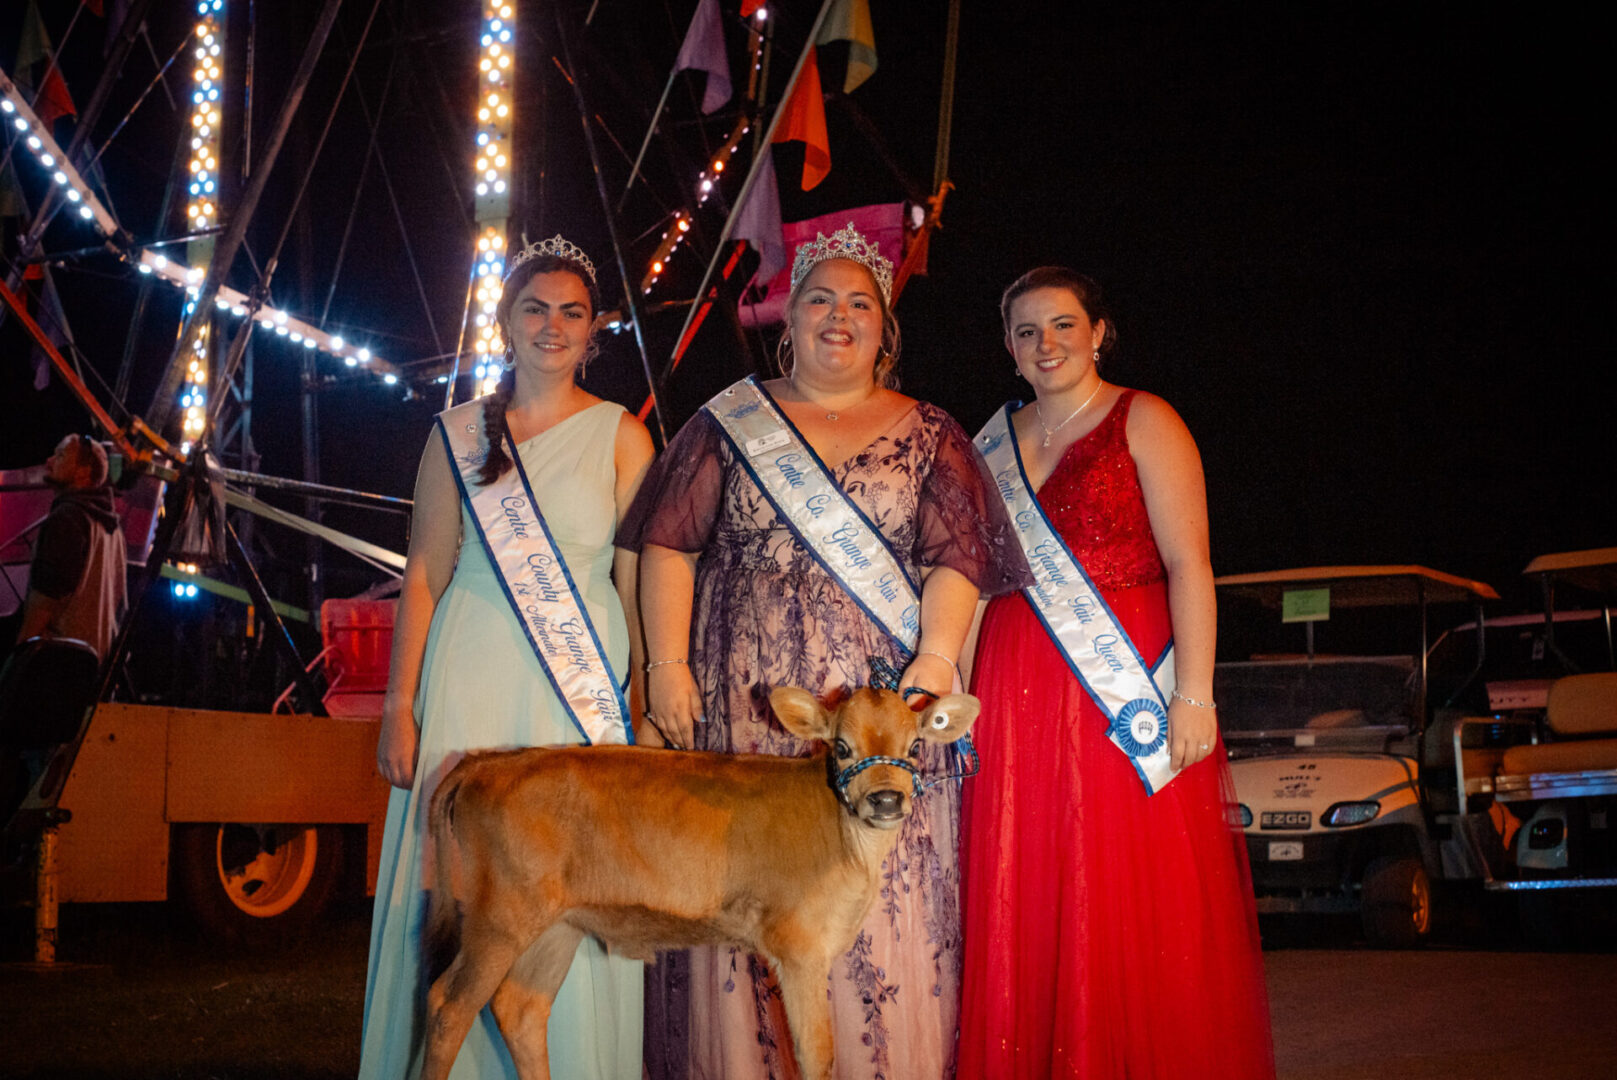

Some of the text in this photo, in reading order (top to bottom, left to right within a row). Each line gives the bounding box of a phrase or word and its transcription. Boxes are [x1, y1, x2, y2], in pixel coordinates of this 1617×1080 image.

[501, 496, 615, 720] Centre County Grange Fair
[514, 582, 559, 657] 1st Alternate
[775, 453, 919, 634] Centre Co. Grange Fair Que
[1015, 510, 1036, 533] Co.
[1027, 539, 1068, 587] Grange
[1067, 594, 1092, 625] Fair
[1091, 633, 1125, 674] Queen
[1262, 812, 1310, 825] EZGO
